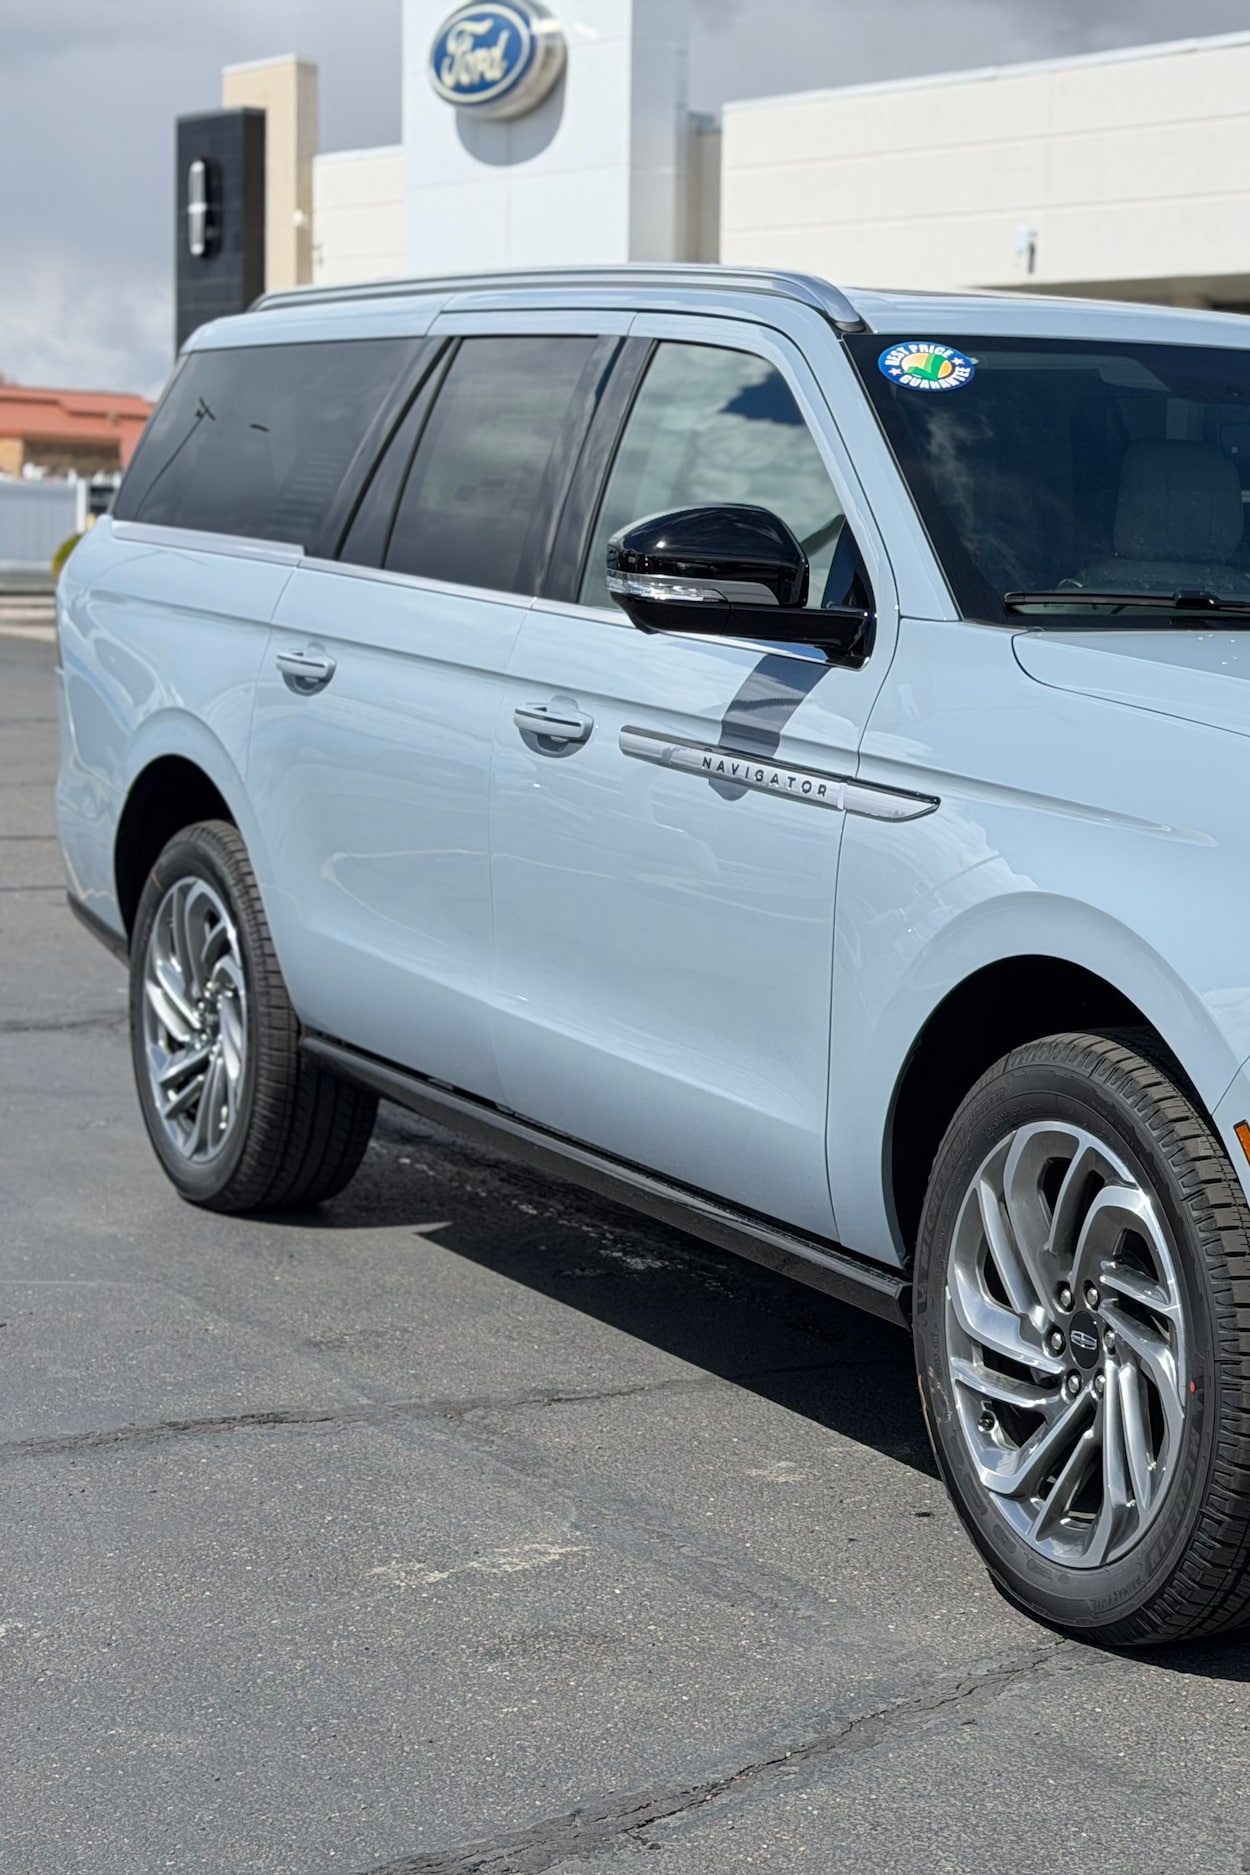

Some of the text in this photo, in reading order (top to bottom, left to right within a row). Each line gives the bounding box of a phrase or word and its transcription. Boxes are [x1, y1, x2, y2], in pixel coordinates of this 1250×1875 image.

[441, 18, 510, 88] Ford
[884, 344, 954, 366] BEST PRICE
[899, 366, 971, 389] GUARANTEE
[701, 756, 827, 797] NAVIGATOR
